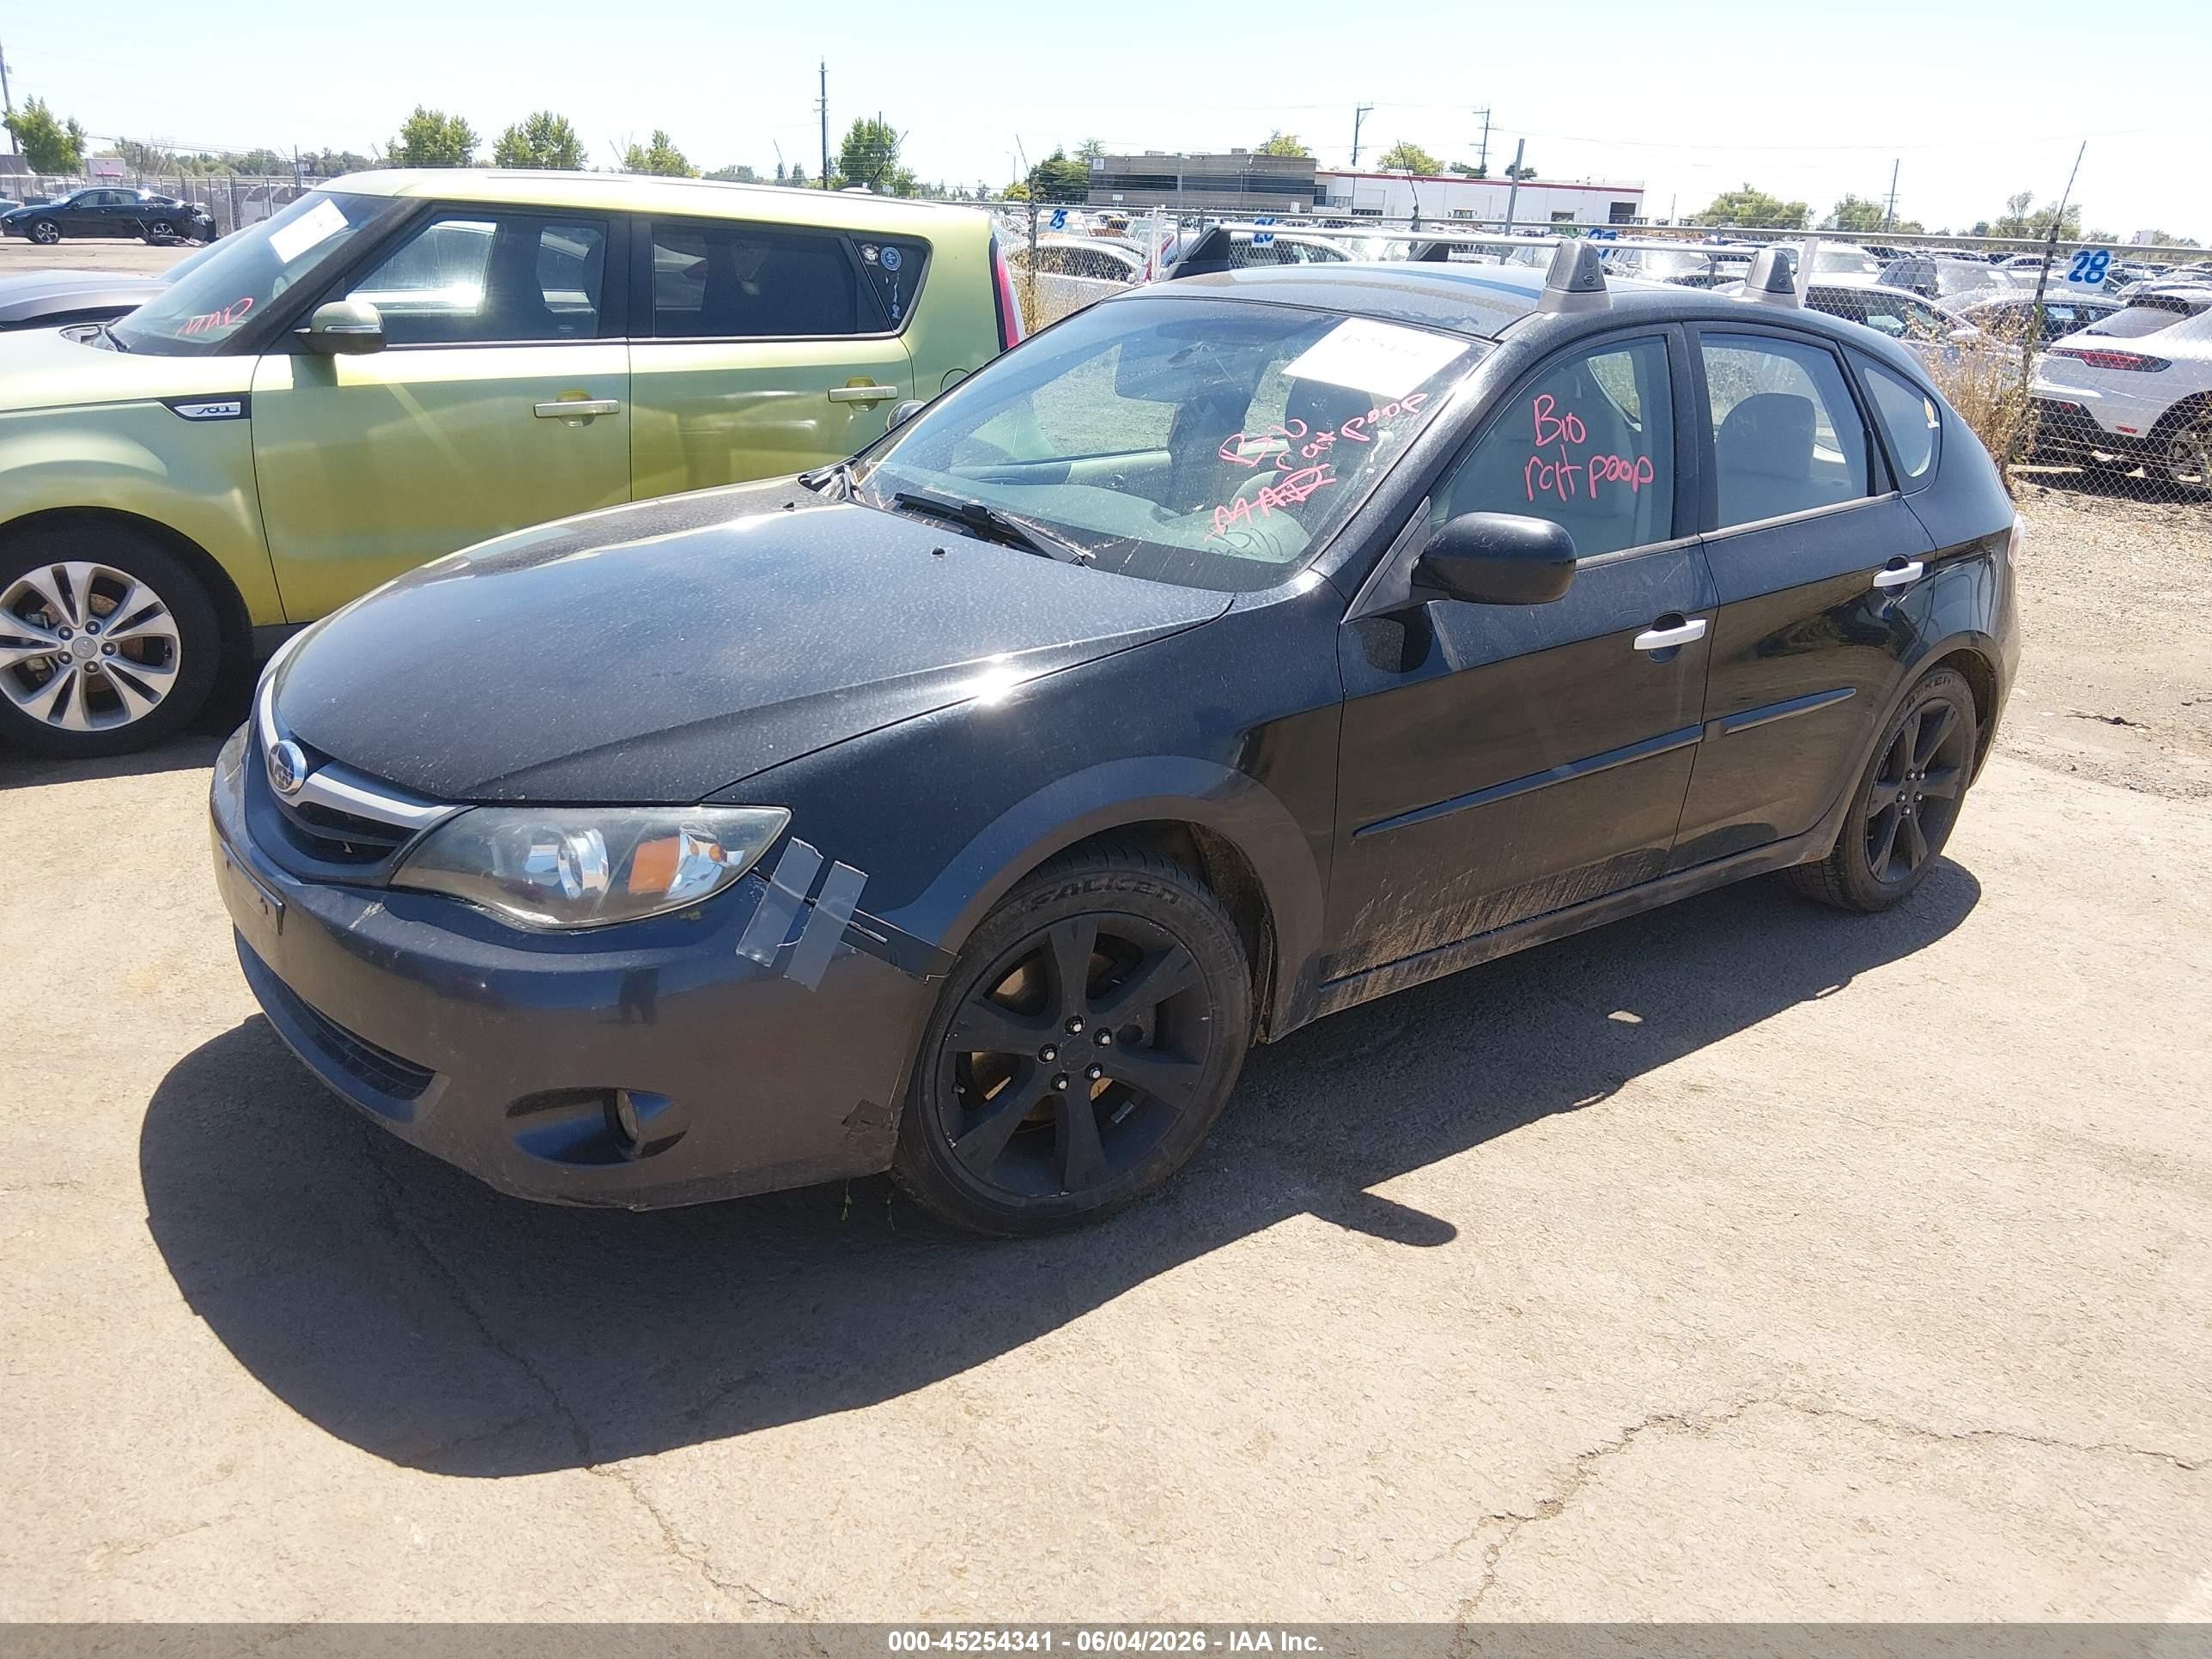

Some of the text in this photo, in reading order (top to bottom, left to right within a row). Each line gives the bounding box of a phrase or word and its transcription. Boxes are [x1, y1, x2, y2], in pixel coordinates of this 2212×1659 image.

[1048, 209, 1068, 229] 25
[2069, 251, 2110, 283] 28
[1589, 454, 1654, 499] poop
